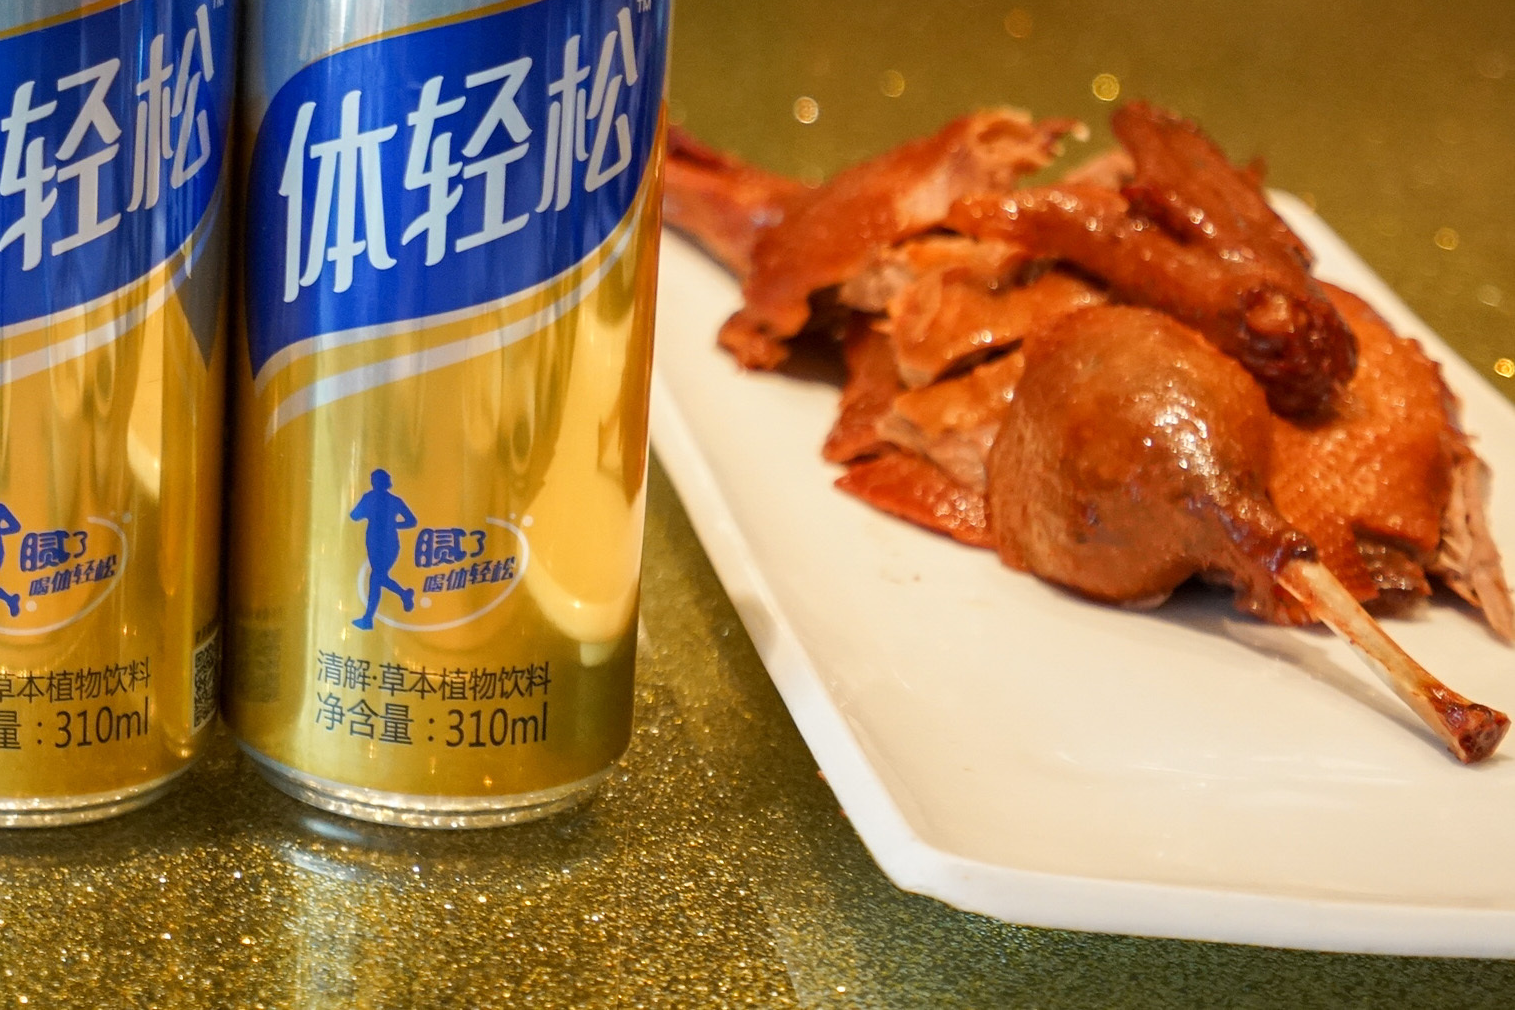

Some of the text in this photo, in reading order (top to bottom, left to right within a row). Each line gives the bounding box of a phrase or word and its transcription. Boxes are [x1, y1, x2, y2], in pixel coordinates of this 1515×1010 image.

[278, 6, 639, 303] 体轻松
[29, 554, 117, 596] 喝体轻松
